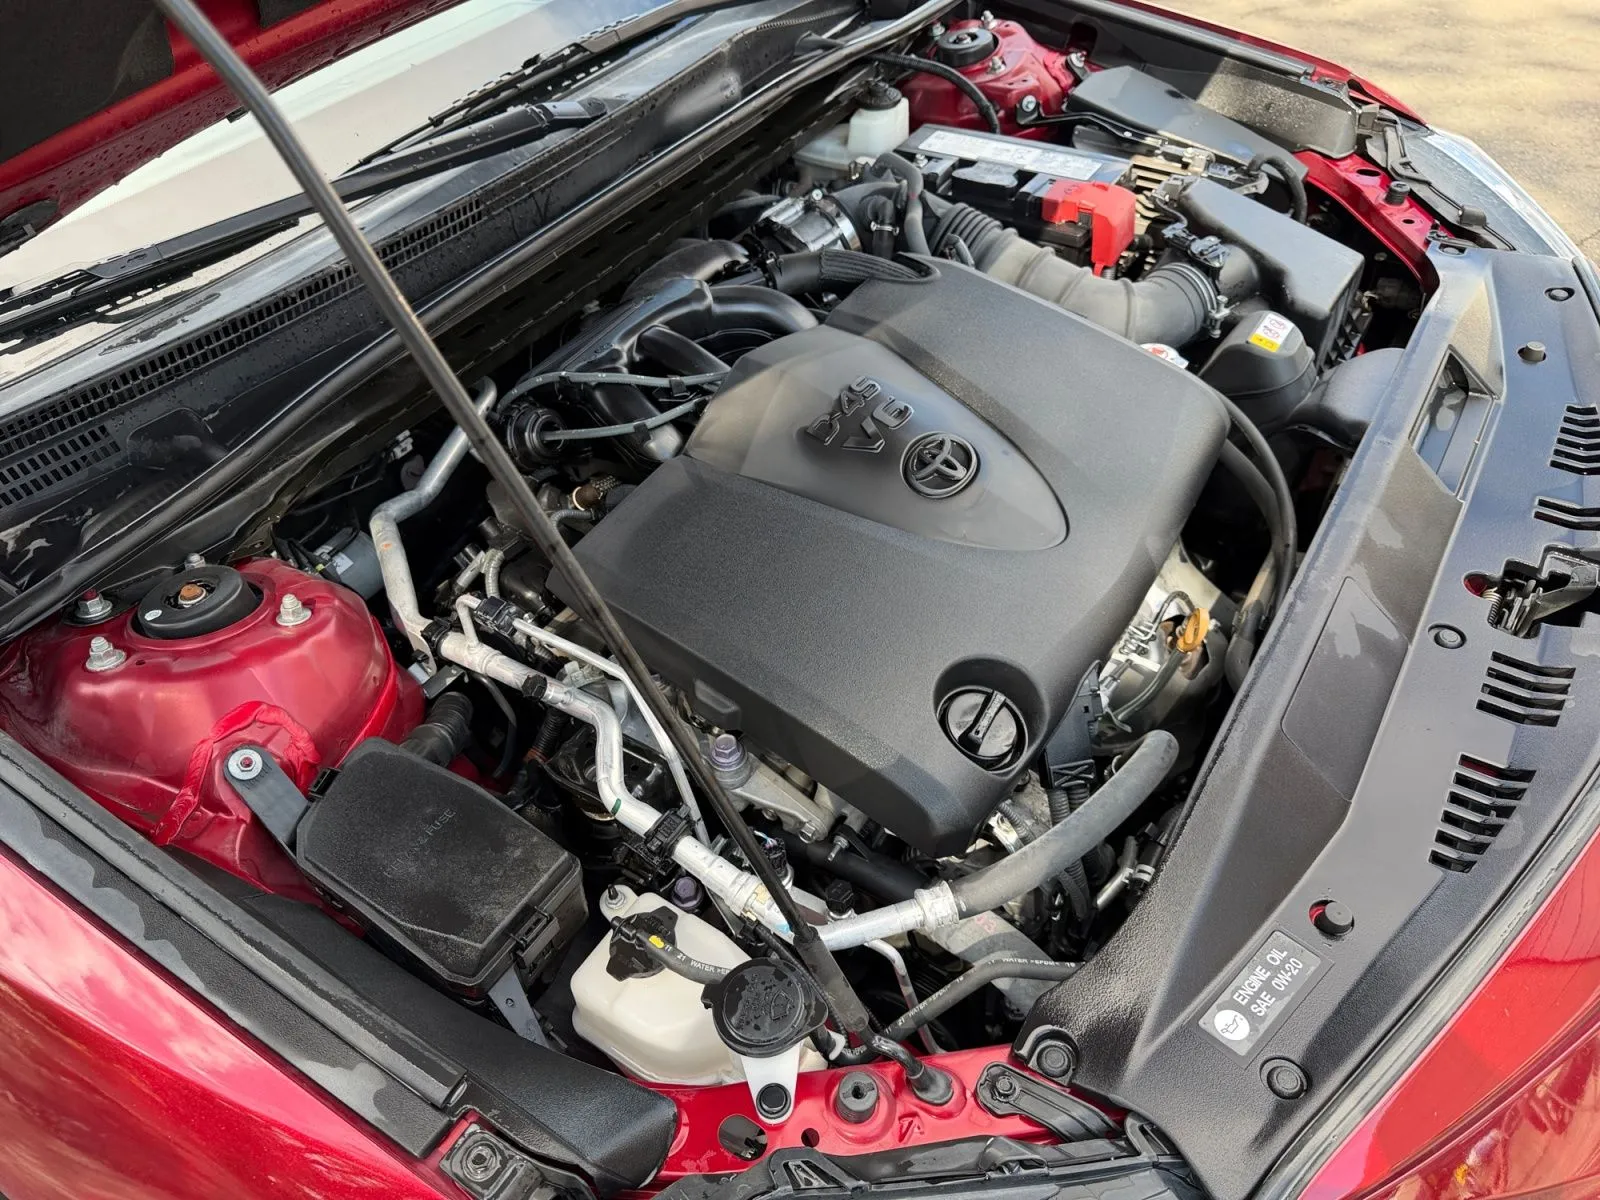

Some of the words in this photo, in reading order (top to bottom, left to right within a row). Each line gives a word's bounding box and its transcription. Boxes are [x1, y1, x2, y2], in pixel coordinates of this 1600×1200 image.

[806, 375, 881, 446] D-4S
[841, 395, 914, 453] V6
[425, 808, 456, 836] FUSE
[677, 952, 686, 961] 21
[690, 960, 715, 973] WATER
[1233, 965, 1271, 1006] ENGINE
[1266, 948, 1288, 966] OIL
[1250, 991, 1276, 1017] SAE
[1271, 957, 1303, 991] 0W-20
[908, 1000, 928, 1017] WATER
